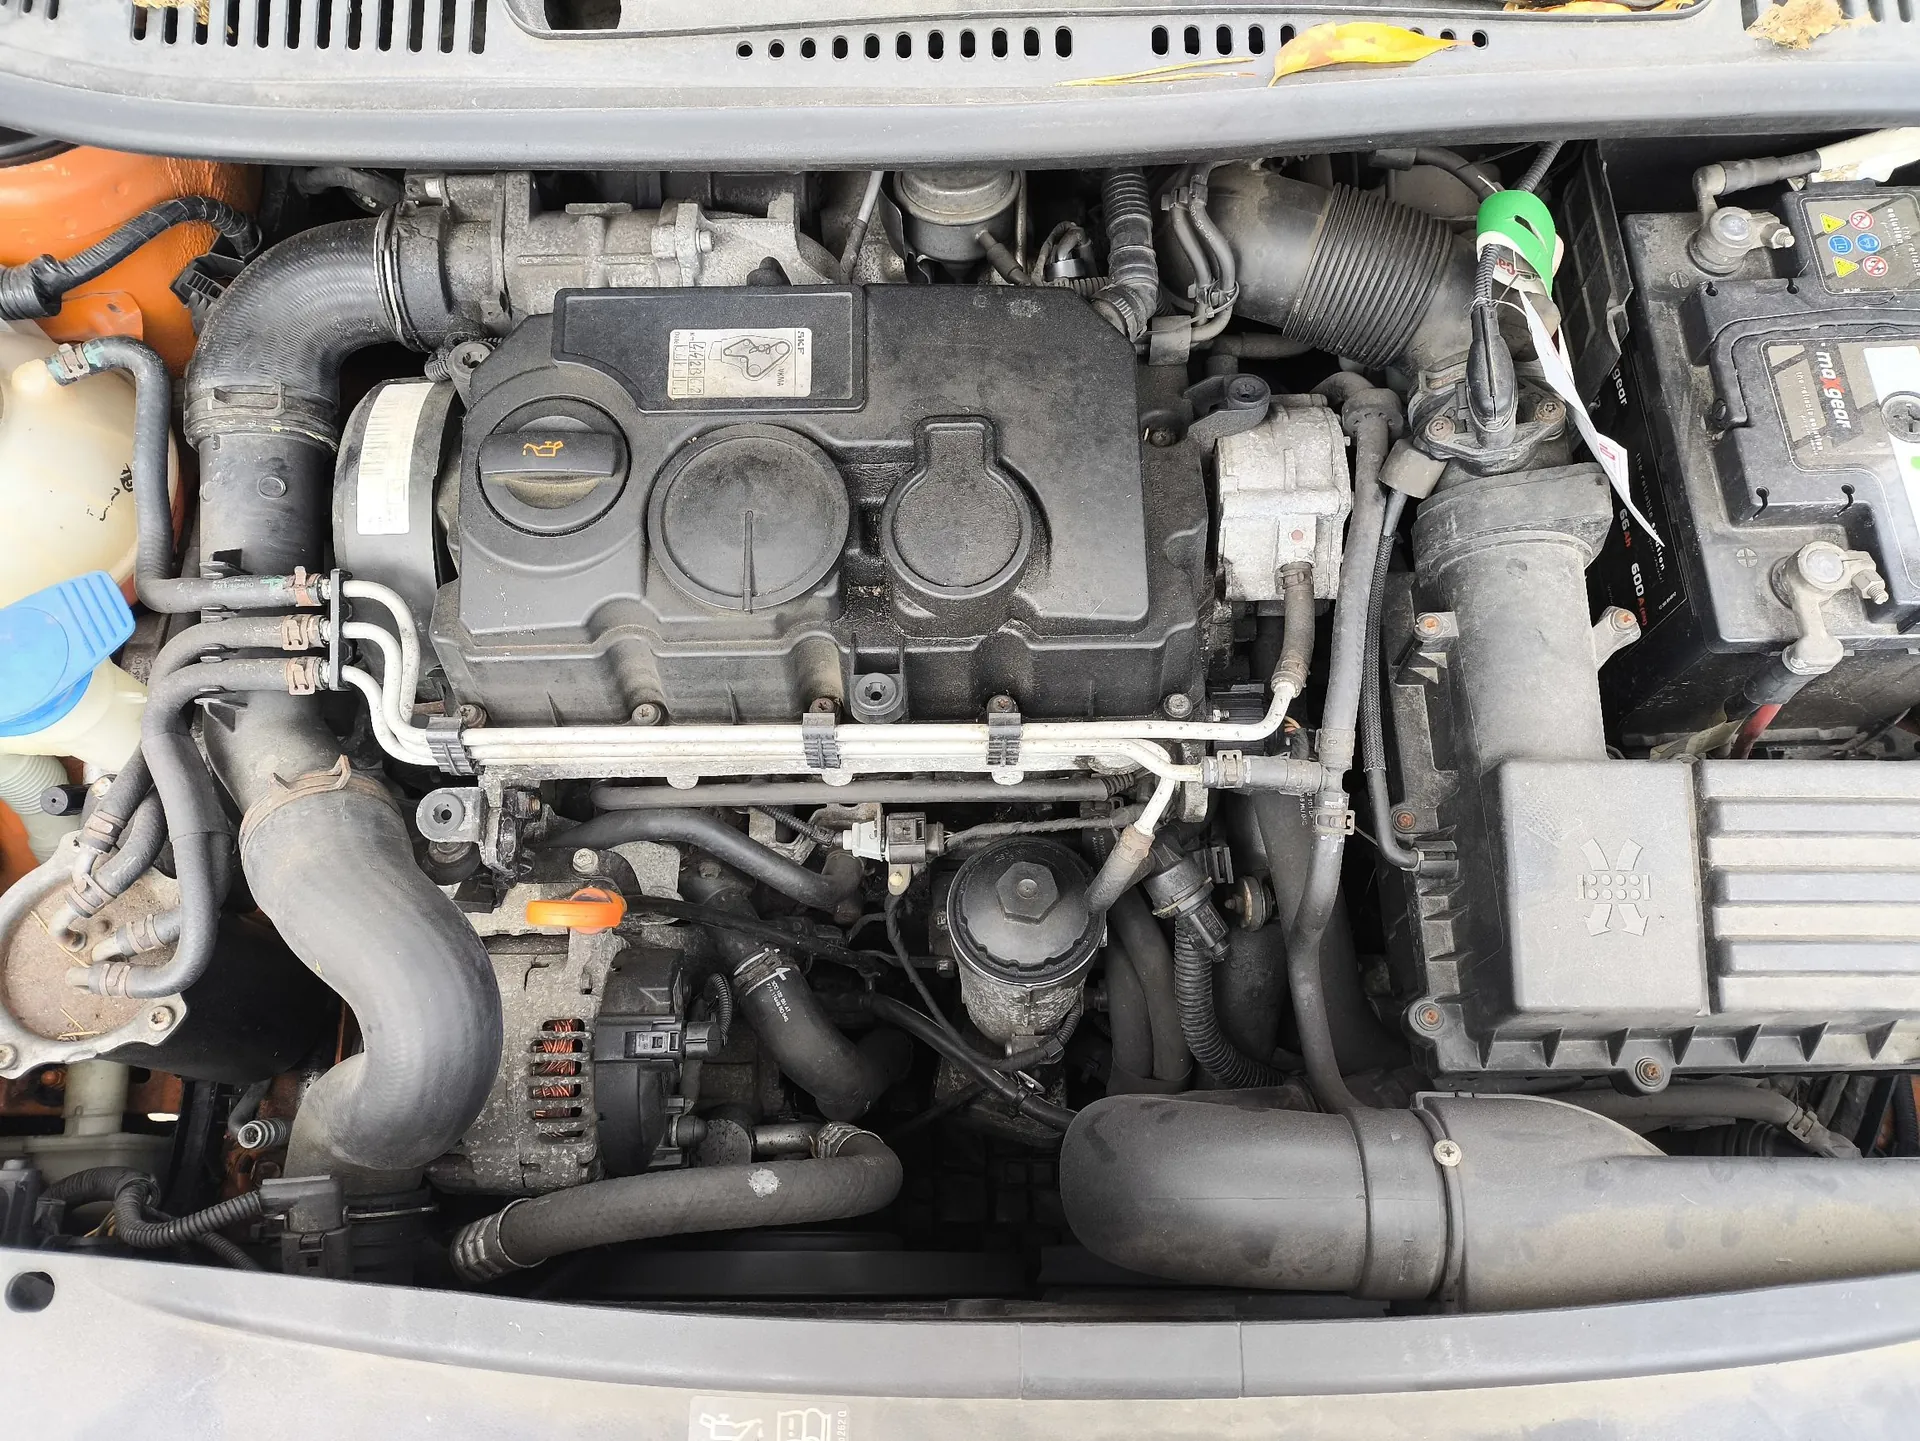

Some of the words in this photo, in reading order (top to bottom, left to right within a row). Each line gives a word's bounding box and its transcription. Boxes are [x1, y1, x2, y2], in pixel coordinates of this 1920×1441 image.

[1887, 208, 1904, 244] solution
[1902, 226, 1912, 240] the
[797, 331, 805, 355] SKF
[777, 367, 785, 387] VKMA
[1612, 367, 1628, 407] gear
[1795, 371, 1805, 384] the
[1620, 508, 1632, 548] 66Ah
